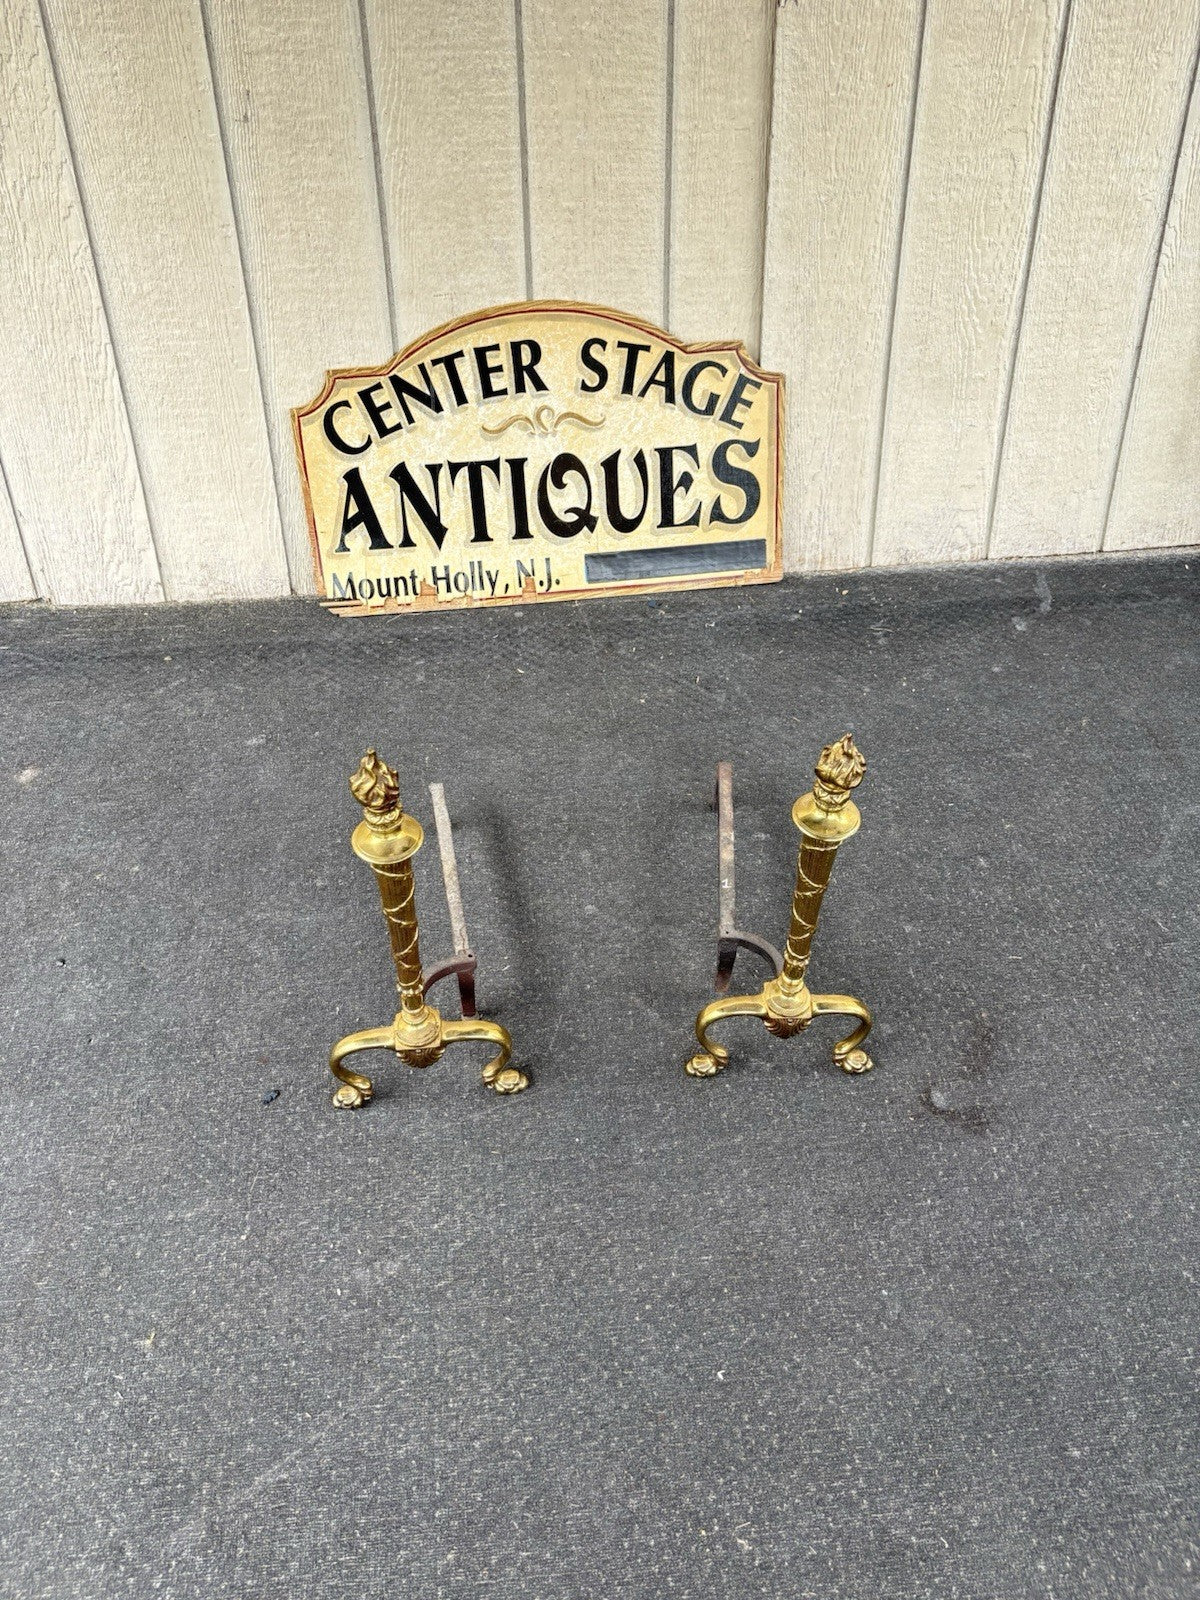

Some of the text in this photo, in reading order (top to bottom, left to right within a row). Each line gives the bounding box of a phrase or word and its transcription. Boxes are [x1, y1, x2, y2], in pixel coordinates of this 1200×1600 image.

[323, 338, 763, 455] CENTER STAGE
[334, 439, 761, 554] ANTIQUES
[332, 557, 561, 602] Mount Holly, N.J.
